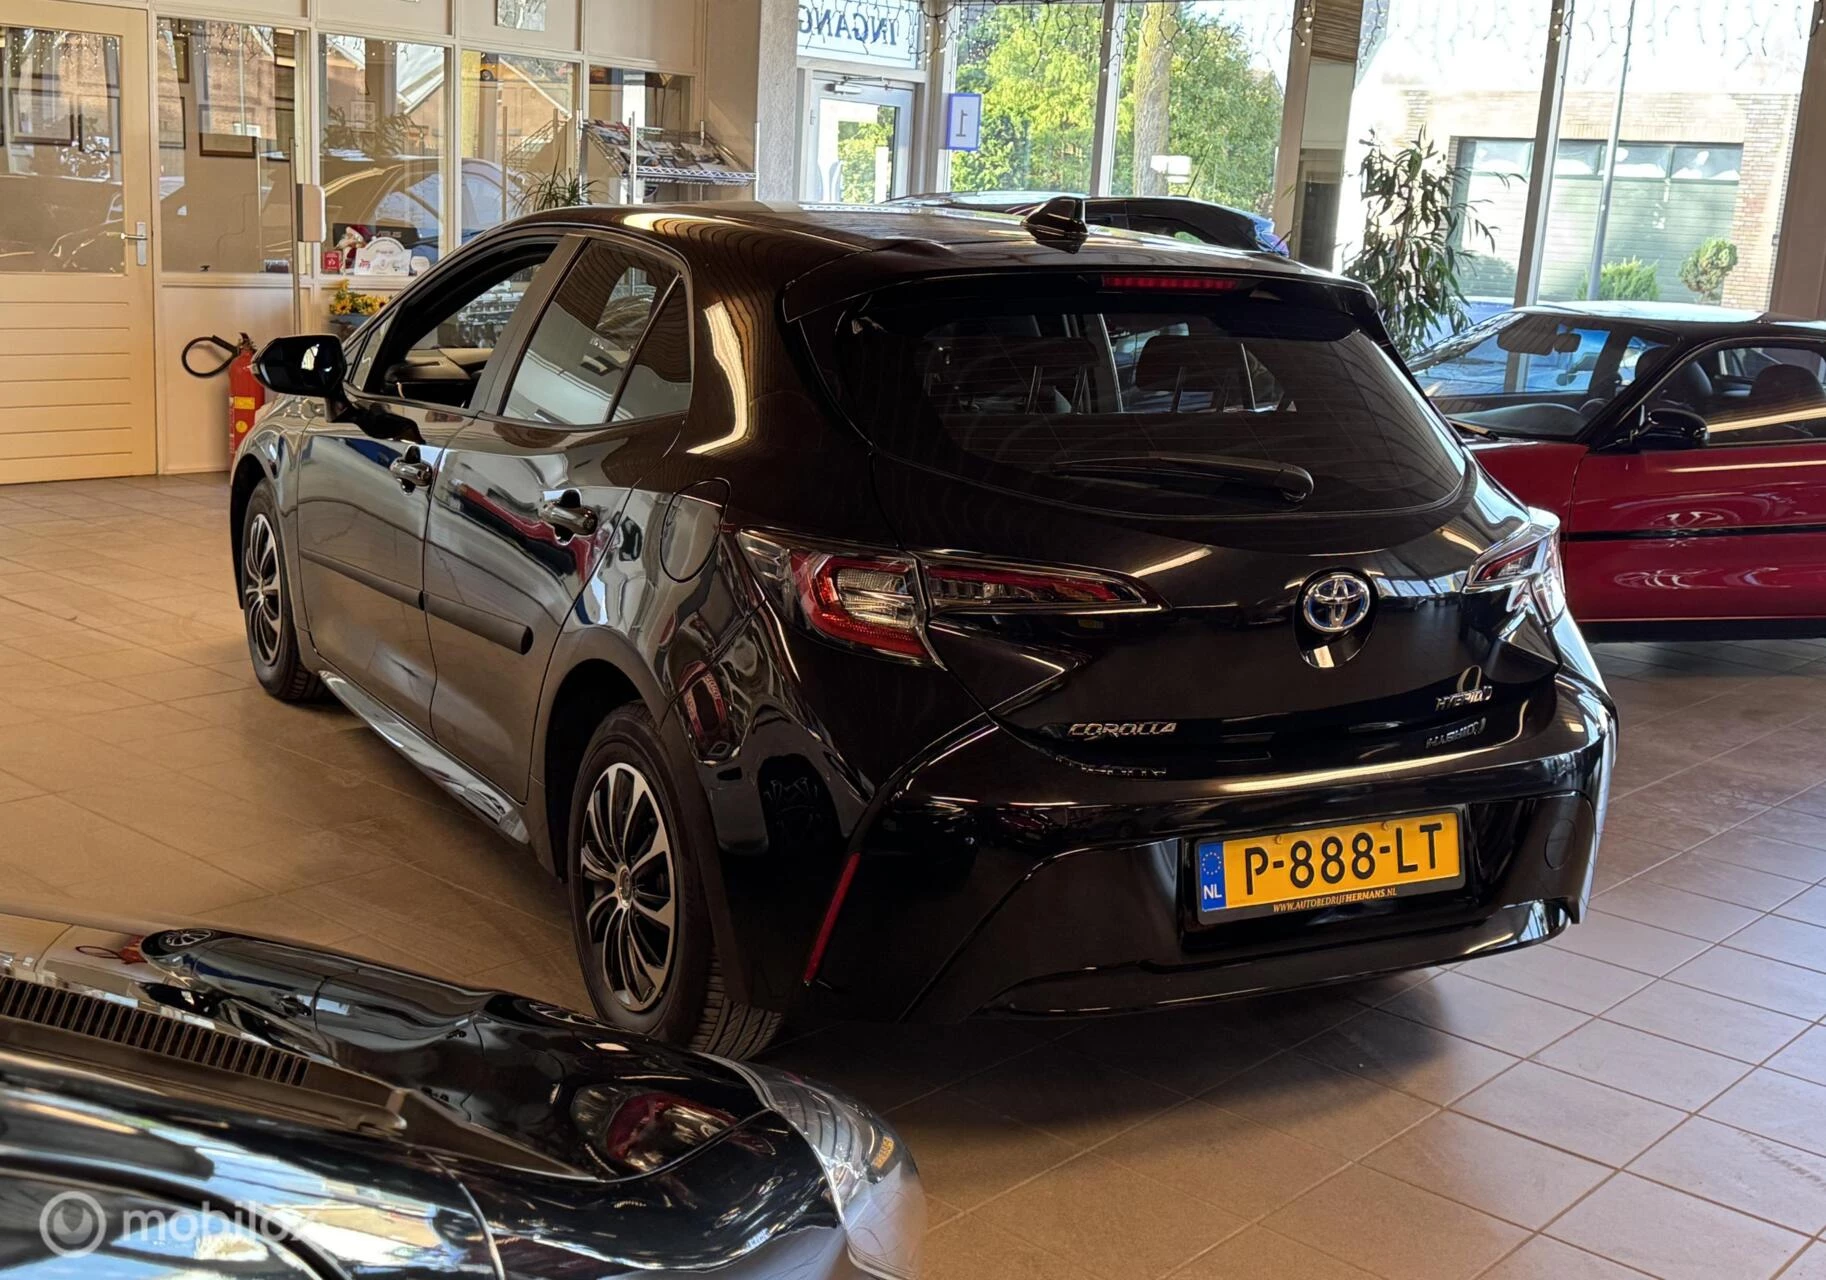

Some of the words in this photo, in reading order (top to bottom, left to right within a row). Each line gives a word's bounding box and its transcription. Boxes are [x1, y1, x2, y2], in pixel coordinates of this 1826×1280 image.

[1434, 689, 1484, 711] HYBRID
[1066, 722, 1177, 741] COROLLA
[1245, 822, 1443, 895] P-888-LT
[1203, 884, 1222, 900] NL
[1272, 887, 1397, 913] WWW.AUTOBEDRIJFHERMANS.NL
